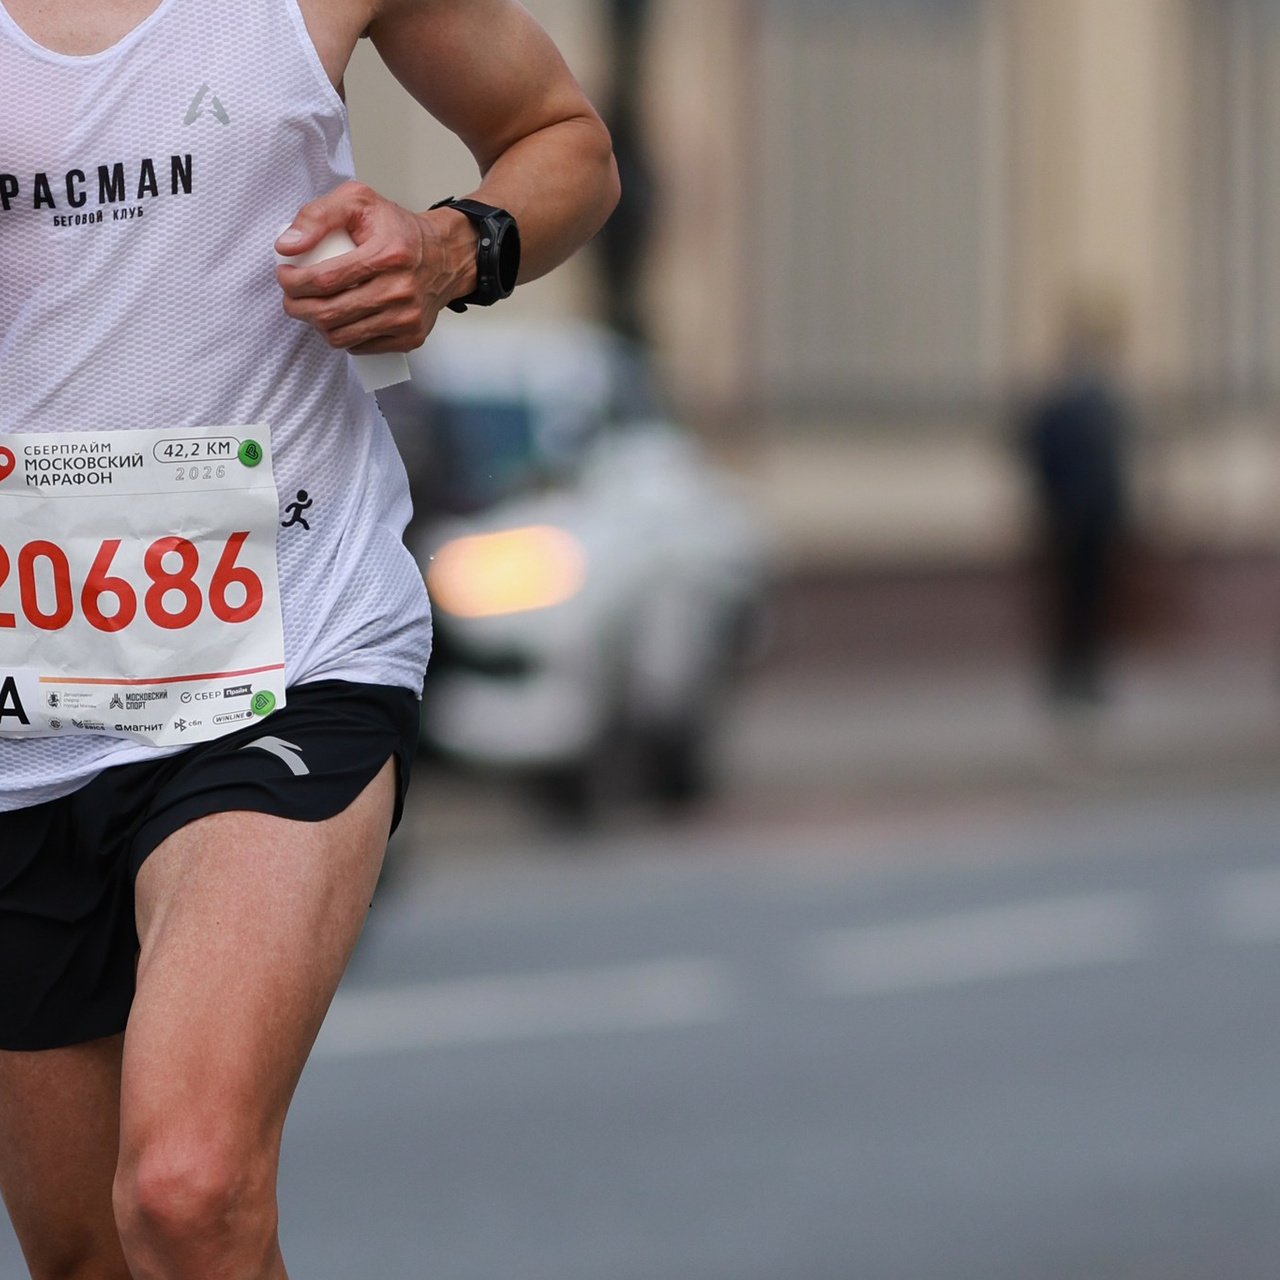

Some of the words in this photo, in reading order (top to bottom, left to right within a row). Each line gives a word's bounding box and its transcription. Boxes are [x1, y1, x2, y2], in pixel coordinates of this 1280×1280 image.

[53, 210, 103, 227] БЕГОВОЙ
[113, 206, 144, 221] КЛУБ
[24, 442, 111, 456] СБЕРПРАЙМ
[163, 443, 200, 459] 42,2
[25, 452, 144, 471] МОСКОВСКИЙ
[26, 471, 112, 486] МАРАФОН
[175, 465, 226, 481] 2026
[125, 689, 168, 701] МОСКОВСКИЙ
[194, 691, 221, 701] СБЕР
[226, 687, 248, 696] Прайм
[126, 701, 146, 710] СПОРТ
[215, 712, 245, 722] WINLINE
